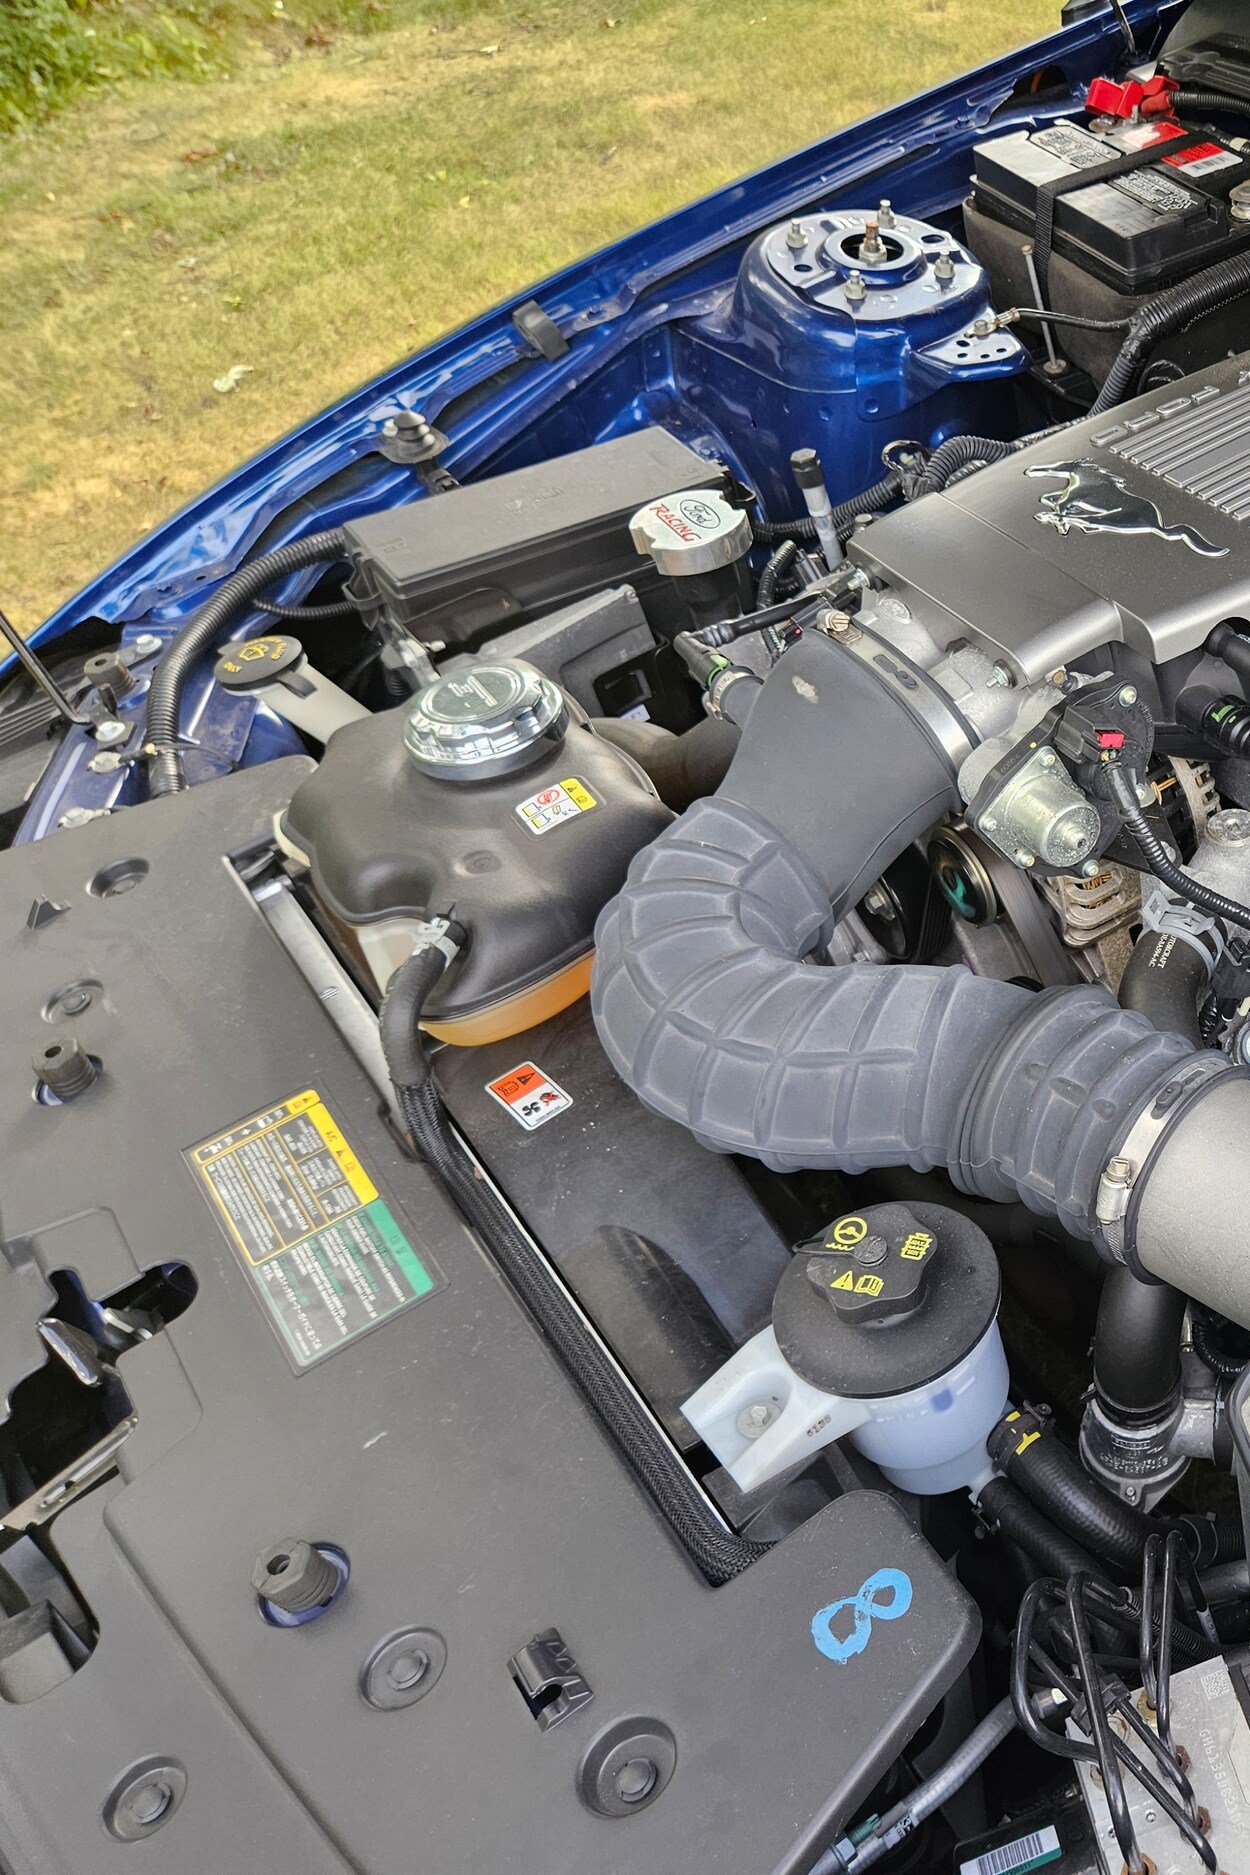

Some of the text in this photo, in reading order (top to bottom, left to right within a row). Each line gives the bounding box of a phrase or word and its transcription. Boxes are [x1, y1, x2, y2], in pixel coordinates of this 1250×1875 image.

[1090, 385, 1221, 447] FORD
[649, 503, 702, 543] RACING
[684, 505, 713, 525] Ford
[1160, 934, 1178, 970] OTORCRAFT
